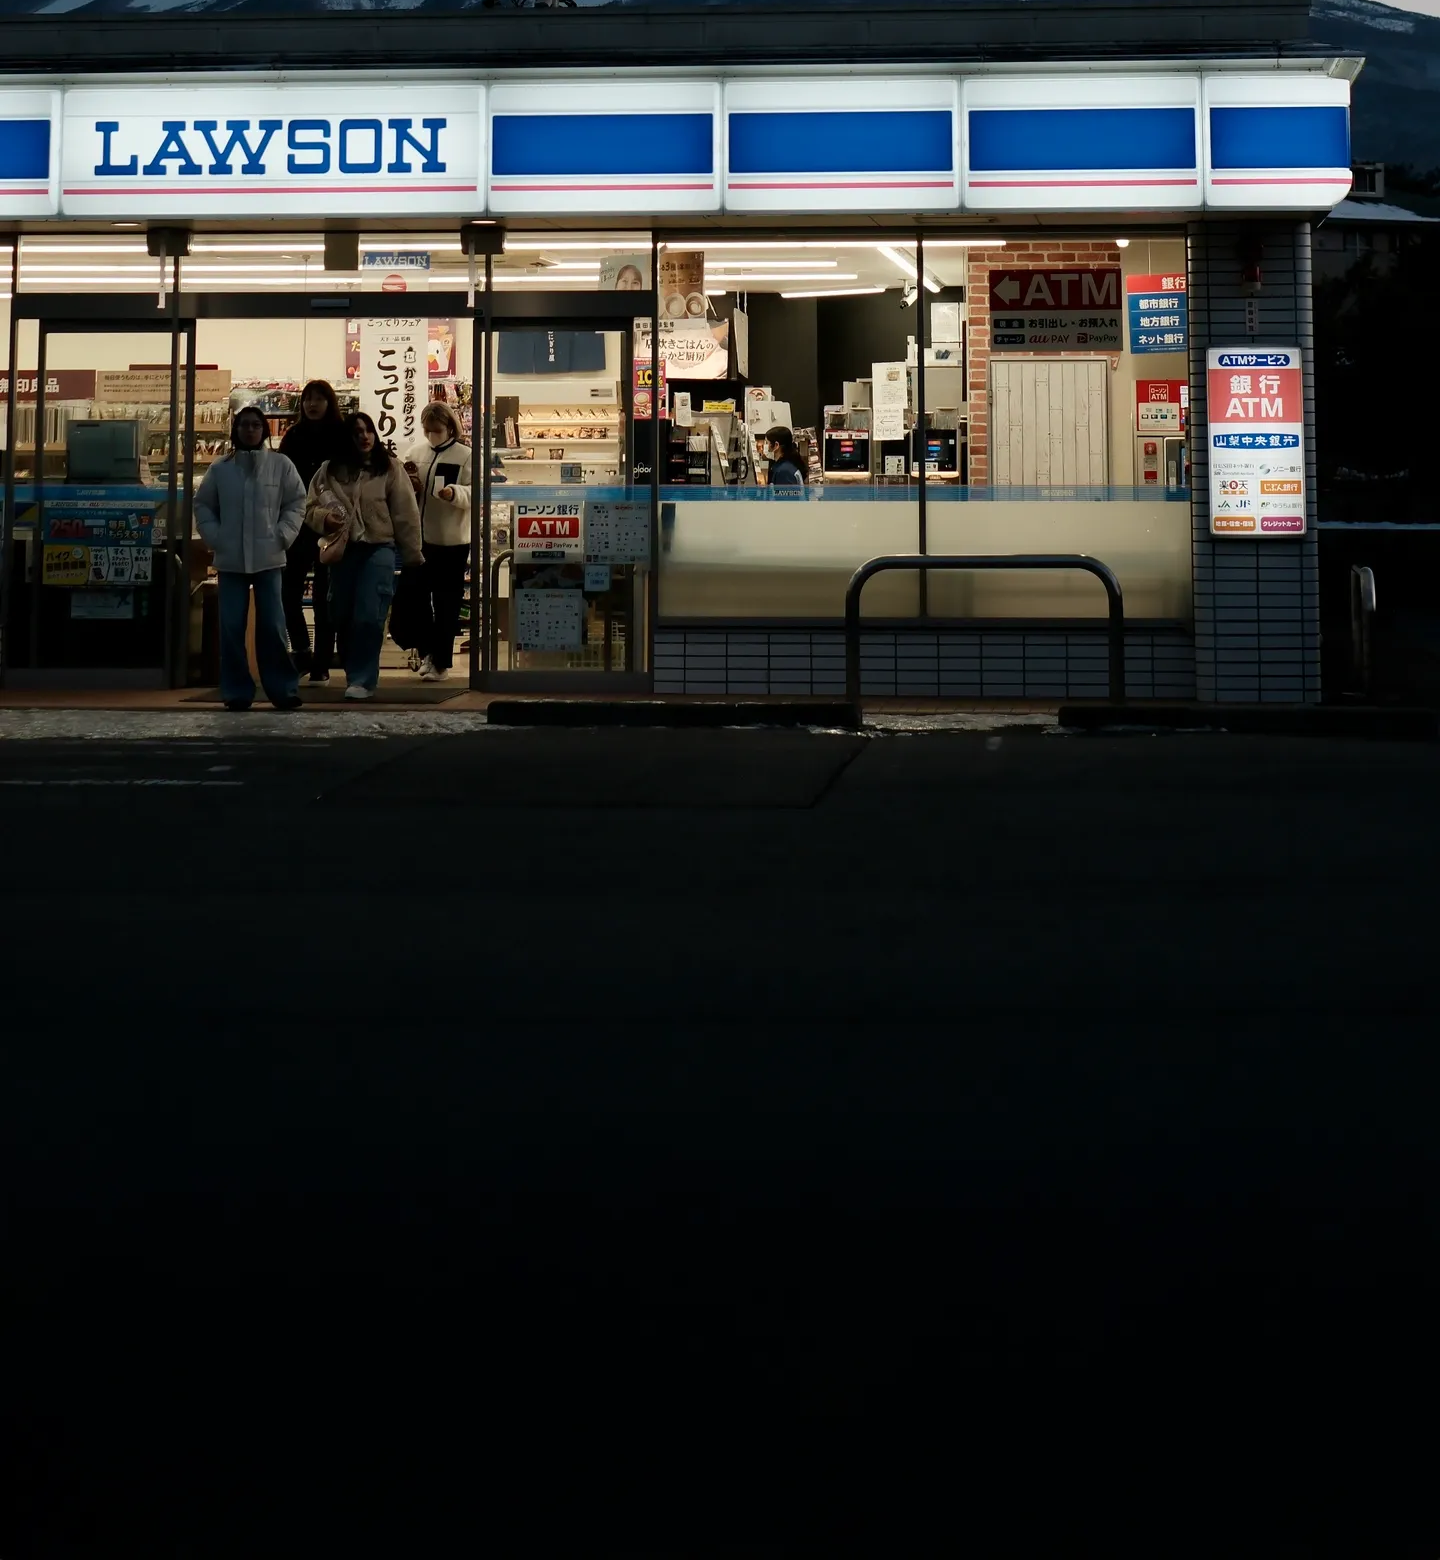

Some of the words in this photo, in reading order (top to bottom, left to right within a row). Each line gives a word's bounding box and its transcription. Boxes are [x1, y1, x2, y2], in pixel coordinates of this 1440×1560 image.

[94, 118, 448, 176] LAWSON
[364, 255, 428, 267] LAWSON
[1161, 276, 1186, 290] 銀行
[1023, 273, 1117, 306] ATM
[1139, 298, 1178, 309] 都市銀行
[1028, 318, 1118, 329] お引出し・お預入れ
[1140, 315, 1179, 327] 地方銀行
[1051, 334, 1070, 344] PAY
[1089, 333, 1118, 343] PayPay
[1139, 333, 1184, 344] ネット銀行
[1222, 355, 1287, 365] ATMサービス
[1230, 374, 1281, 395] 銀行
[403, 367, 417, 437] からあげクン
[1225, 397, 1283, 418] ATM
[1215, 435, 1296, 446] 山梨中央銀行
[1264, 483, 1298, 492] じぶん銀行
[518, 504, 579, 515] ローソン銀行
[528, 520, 570, 536] ATM
